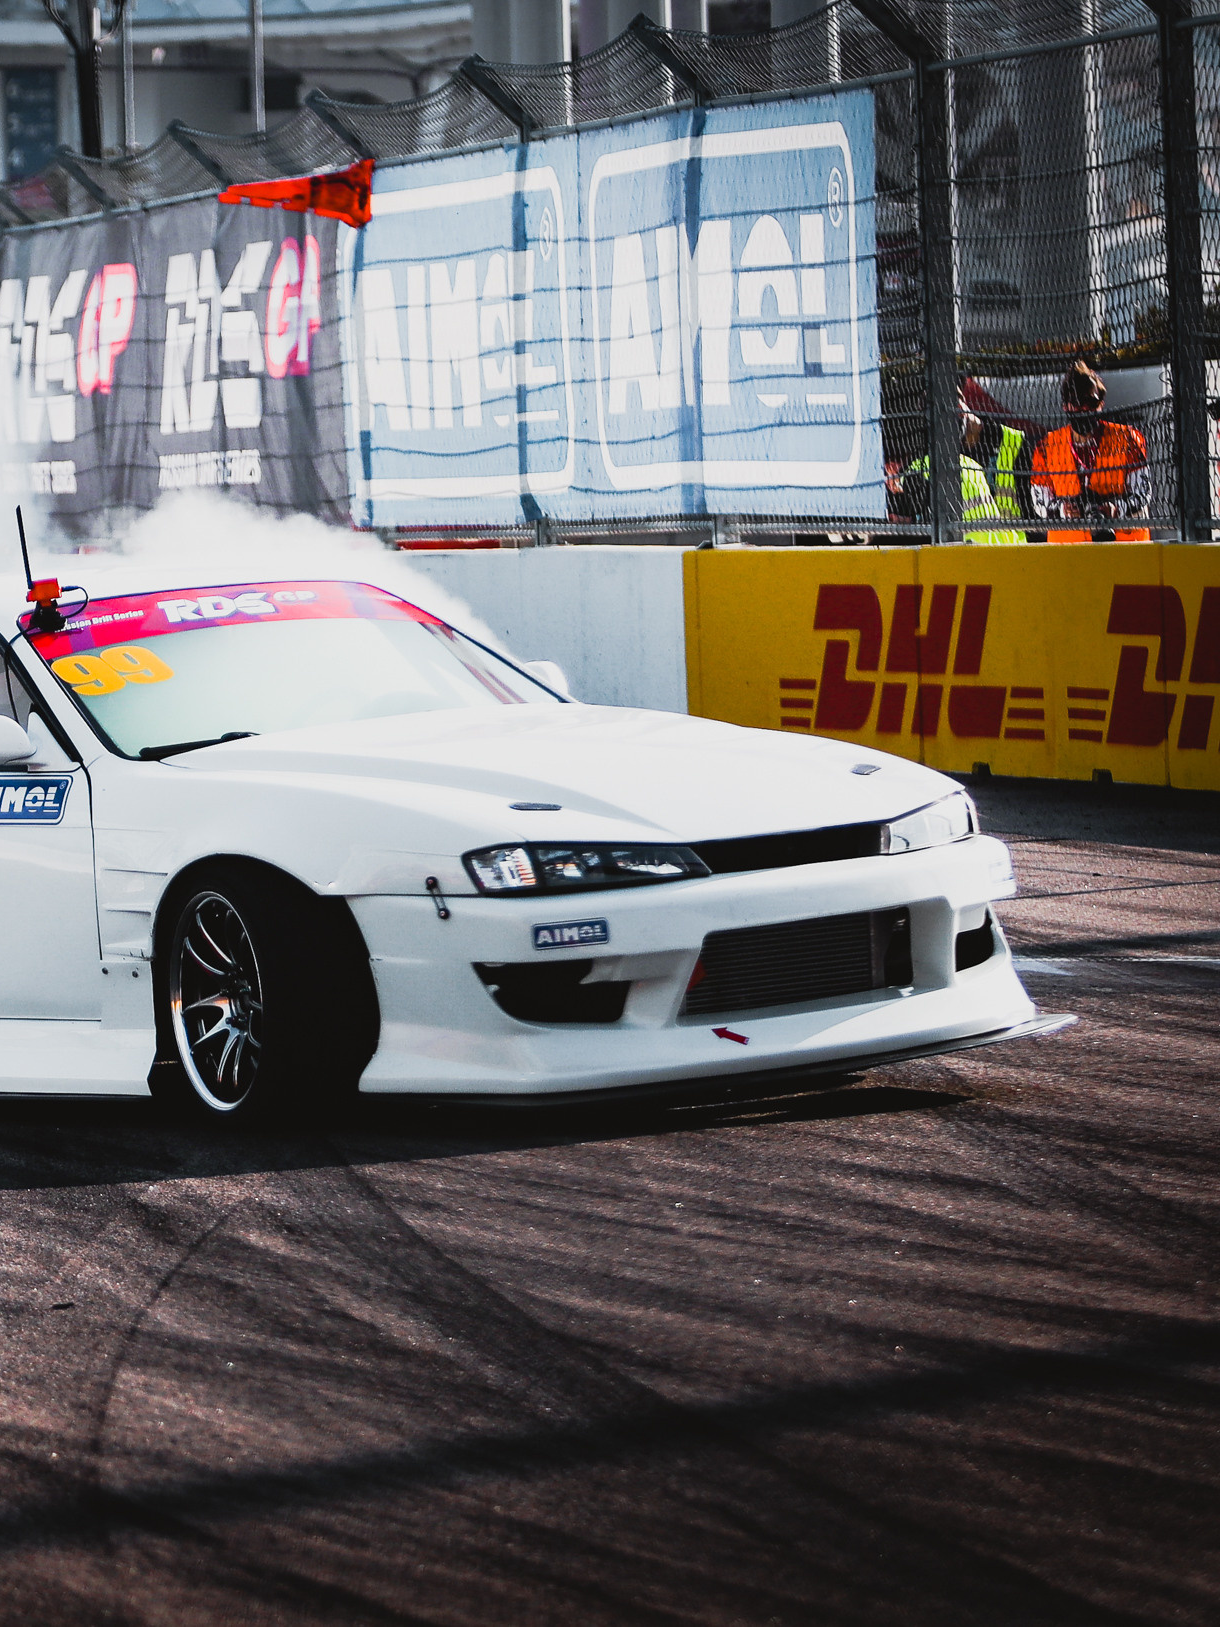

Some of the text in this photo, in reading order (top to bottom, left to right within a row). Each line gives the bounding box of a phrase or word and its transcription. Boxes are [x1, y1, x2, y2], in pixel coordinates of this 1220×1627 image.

[609, 213, 847, 414] AIMOL
[358, 250, 559, 432] AIMOL
[91, 614, 114, 626] Drift
[113, 609, 145, 621] Series
[157, 592, 276, 623] RDS
[51, 645, 174, 696] 99
[813, 583, 1008, 739] DHL
[538, 925, 606, 943] AIMOL
